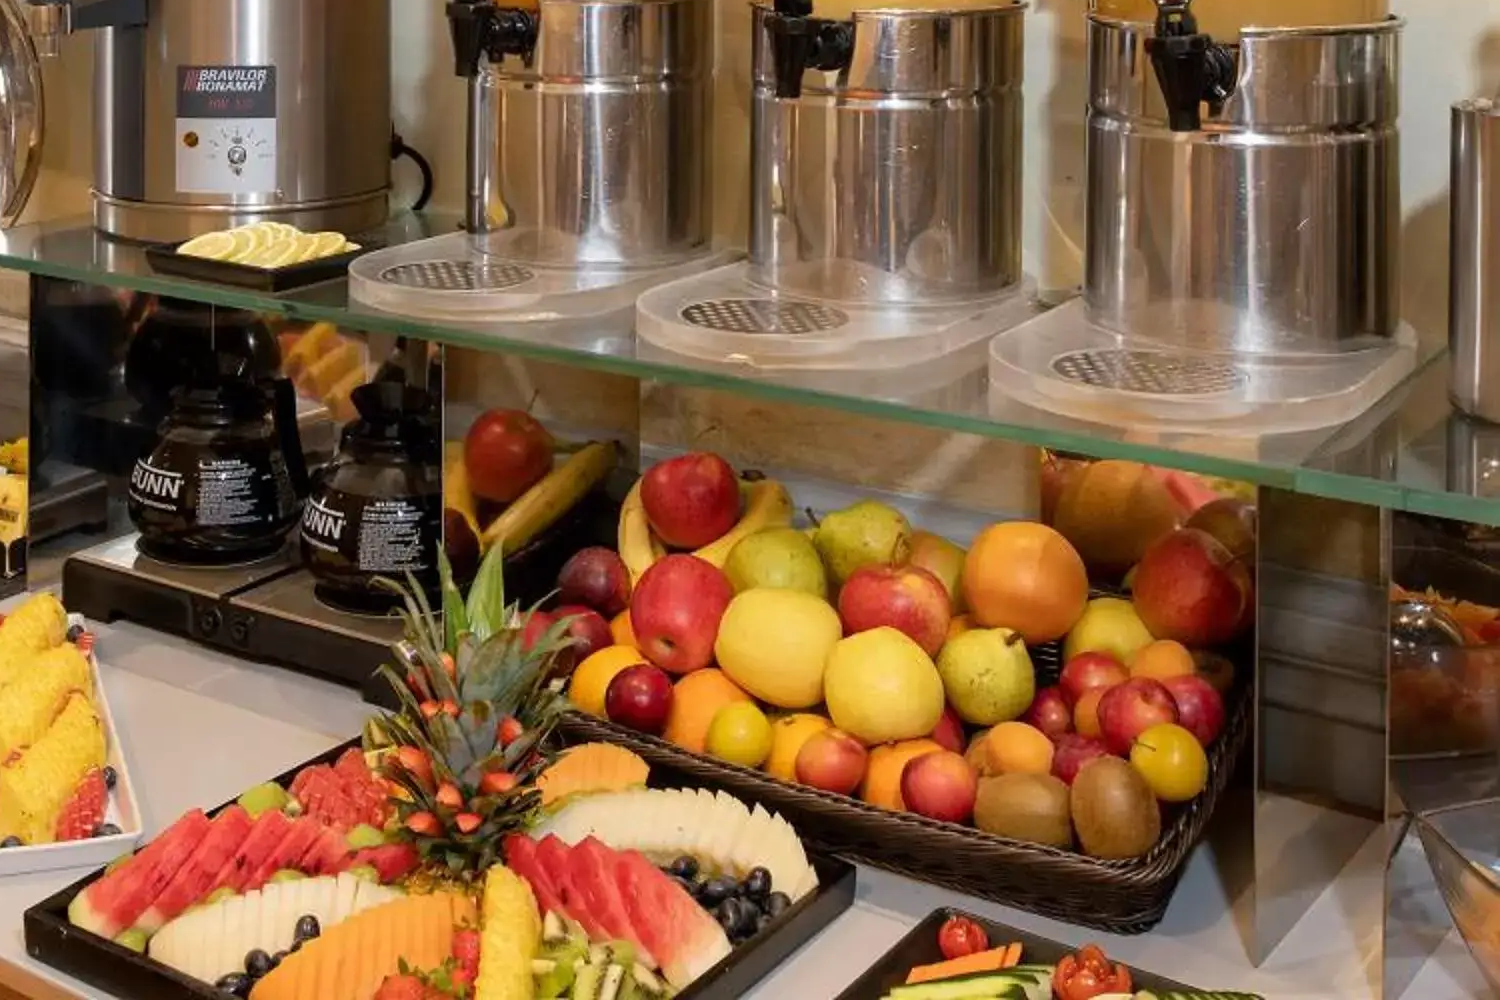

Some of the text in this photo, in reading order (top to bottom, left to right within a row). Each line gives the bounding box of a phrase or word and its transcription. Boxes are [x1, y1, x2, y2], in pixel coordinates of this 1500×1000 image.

[199, 69, 267, 81] BRAVILOR
[195, 81, 265, 92] BONAMAT
[131, 463, 181, 499] BUNN
